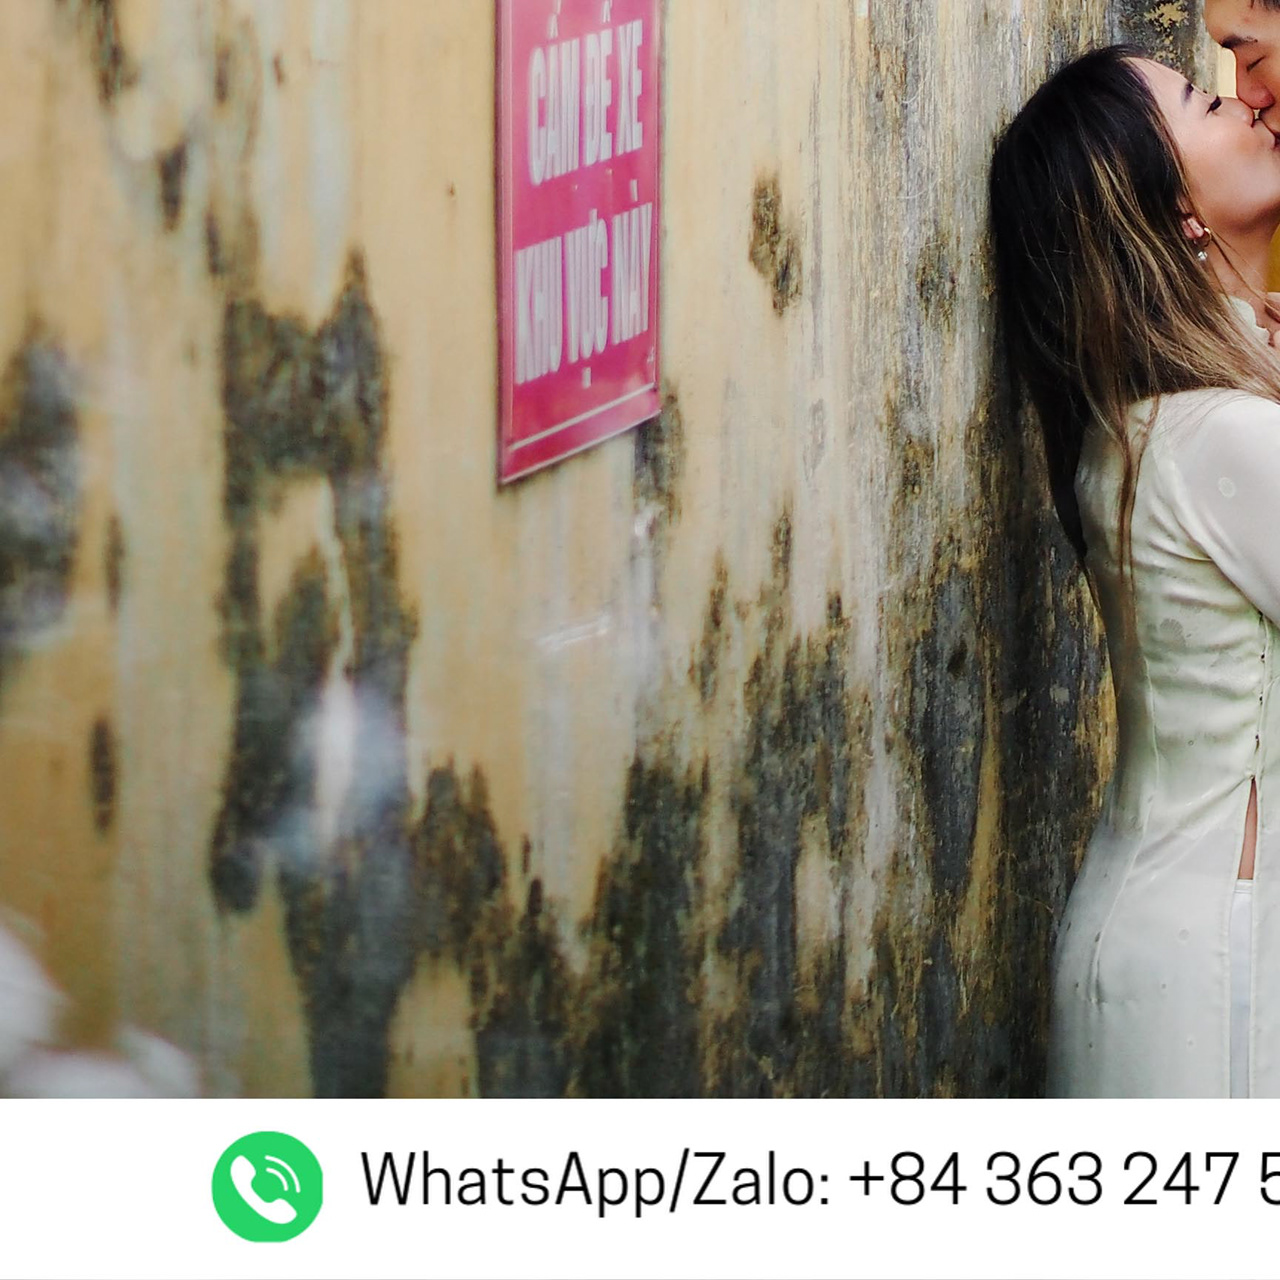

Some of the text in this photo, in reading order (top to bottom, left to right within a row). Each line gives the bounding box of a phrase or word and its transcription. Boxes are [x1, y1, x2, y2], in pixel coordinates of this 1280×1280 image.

[615, 19, 643, 157] XE
[514, 179, 653, 389] KHU VỰC NÀY
